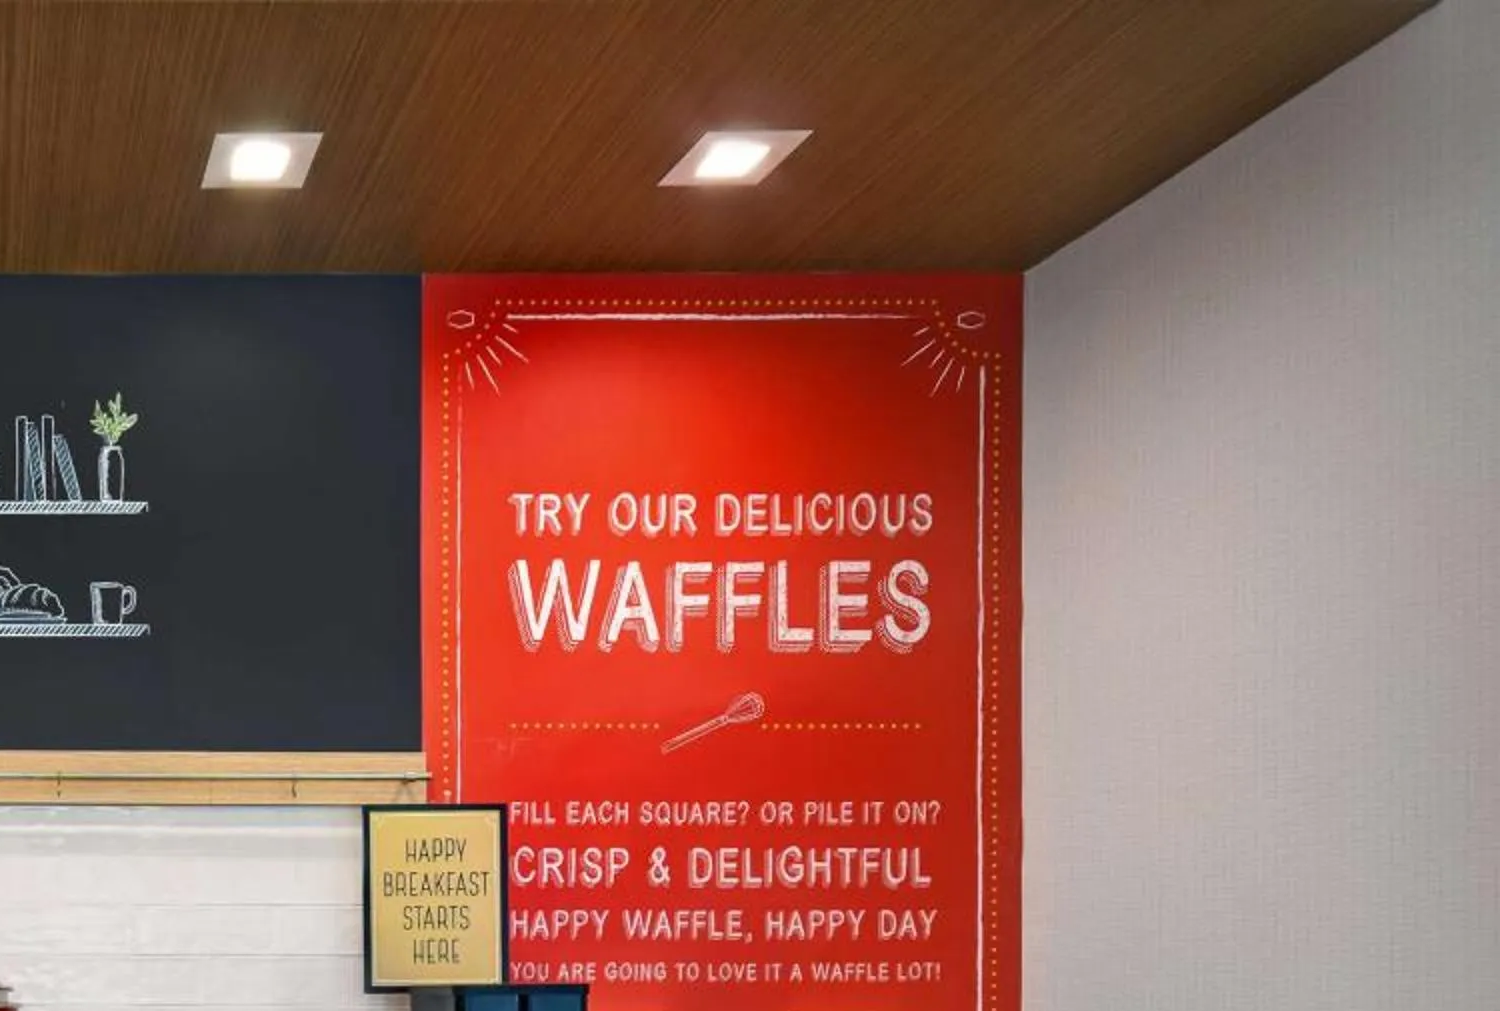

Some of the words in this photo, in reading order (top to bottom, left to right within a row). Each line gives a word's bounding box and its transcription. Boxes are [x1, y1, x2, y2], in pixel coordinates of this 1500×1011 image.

[508, 493, 590, 536] TRY
[608, 493, 697, 536] OUR
[714, 493, 933, 536] DELICIOUS
[507, 560, 931, 653] WAFFLES
[509, 800, 556, 825] FILL
[565, 801, 629, 826] EACH
[639, 801, 750, 826] SQUARE?
[760, 801, 794, 826] OR
[804, 801, 854, 826] PILE
[862, 801, 884, 825] IT
[894, 800, 941, 826] ON?
[405, 838, 467, 863] HAPPY
[511, 846, 630, 888] CRISP
[648, 846, 671, 886] &
[688, 845, 932, 889] DELIGHTFUL
[383, 871, 490, 897] BREAKFAST
[403, 905, 470, 931] STARTS
[510, 909, 609, 941] HAPPY
[622, 909, 753, 944] WAFFLE,
[764, 909, 866, 941] HAPPY
[877, 909, 938, 941] DAY
[413, 938, 461, 965] HERE
[510, 961, 550, 981] YOU
[557, 961, 597, 982] ARE
[604, 961, 668, 982] GOING
[674, 961, 700, 982] TO
[707, 961, 757, 982] LOVE
[764, 962, 783, 981] IT
[790, 962, 803, 982] A
[810, 961, 890, 983] WAFFLE
[896, 961, 942, 982] LOT!
